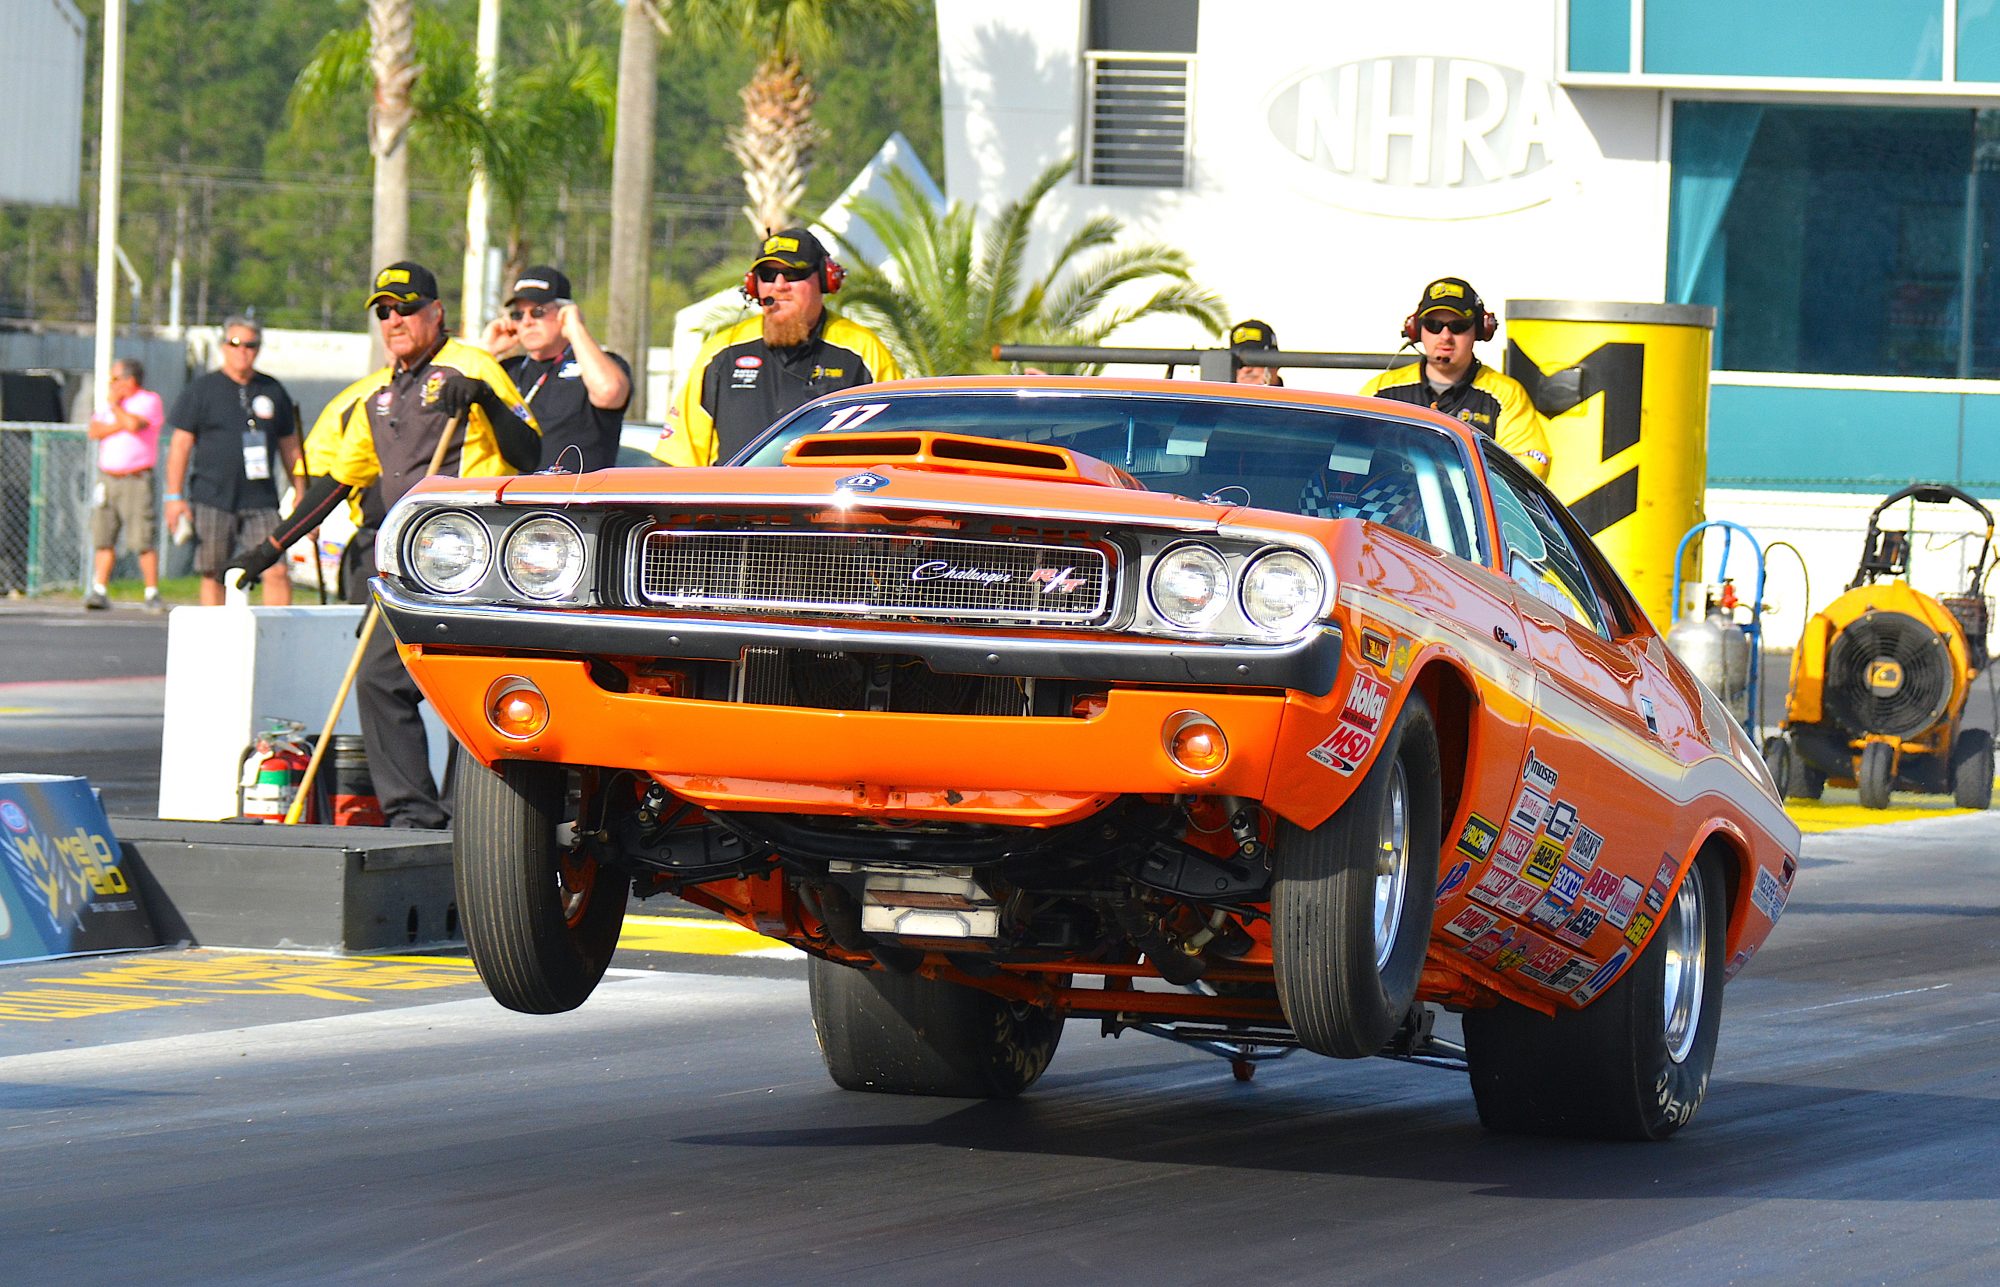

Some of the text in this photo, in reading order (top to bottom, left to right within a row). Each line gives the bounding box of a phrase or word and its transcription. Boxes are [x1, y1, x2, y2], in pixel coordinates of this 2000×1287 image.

[1295, 57, 1553, 187] NHRA
[912, 561, 1088, 594] Challenger R/T
[1346, 673, 1387, 733] Holley
[1322, 726, 1372, 763] MSD
[1531, 760, 1558, 787] MOSER
[1465, 824, 1494, 854] RACEPAK
[1501, 829, 1528, 863] MANLEY
[1534, 845, 1562, 871] EARL'S
[1481, 867, 1511, 898] MANLEY
[1553, 866, 1584, 899] sparco
[1585, 867, 1620, 902] ARP
[1452, 908, 1490, 931] COMP
[1565, 906, 1602, 938] JESEL
[1527, 944, 1569, 974] JESEL
